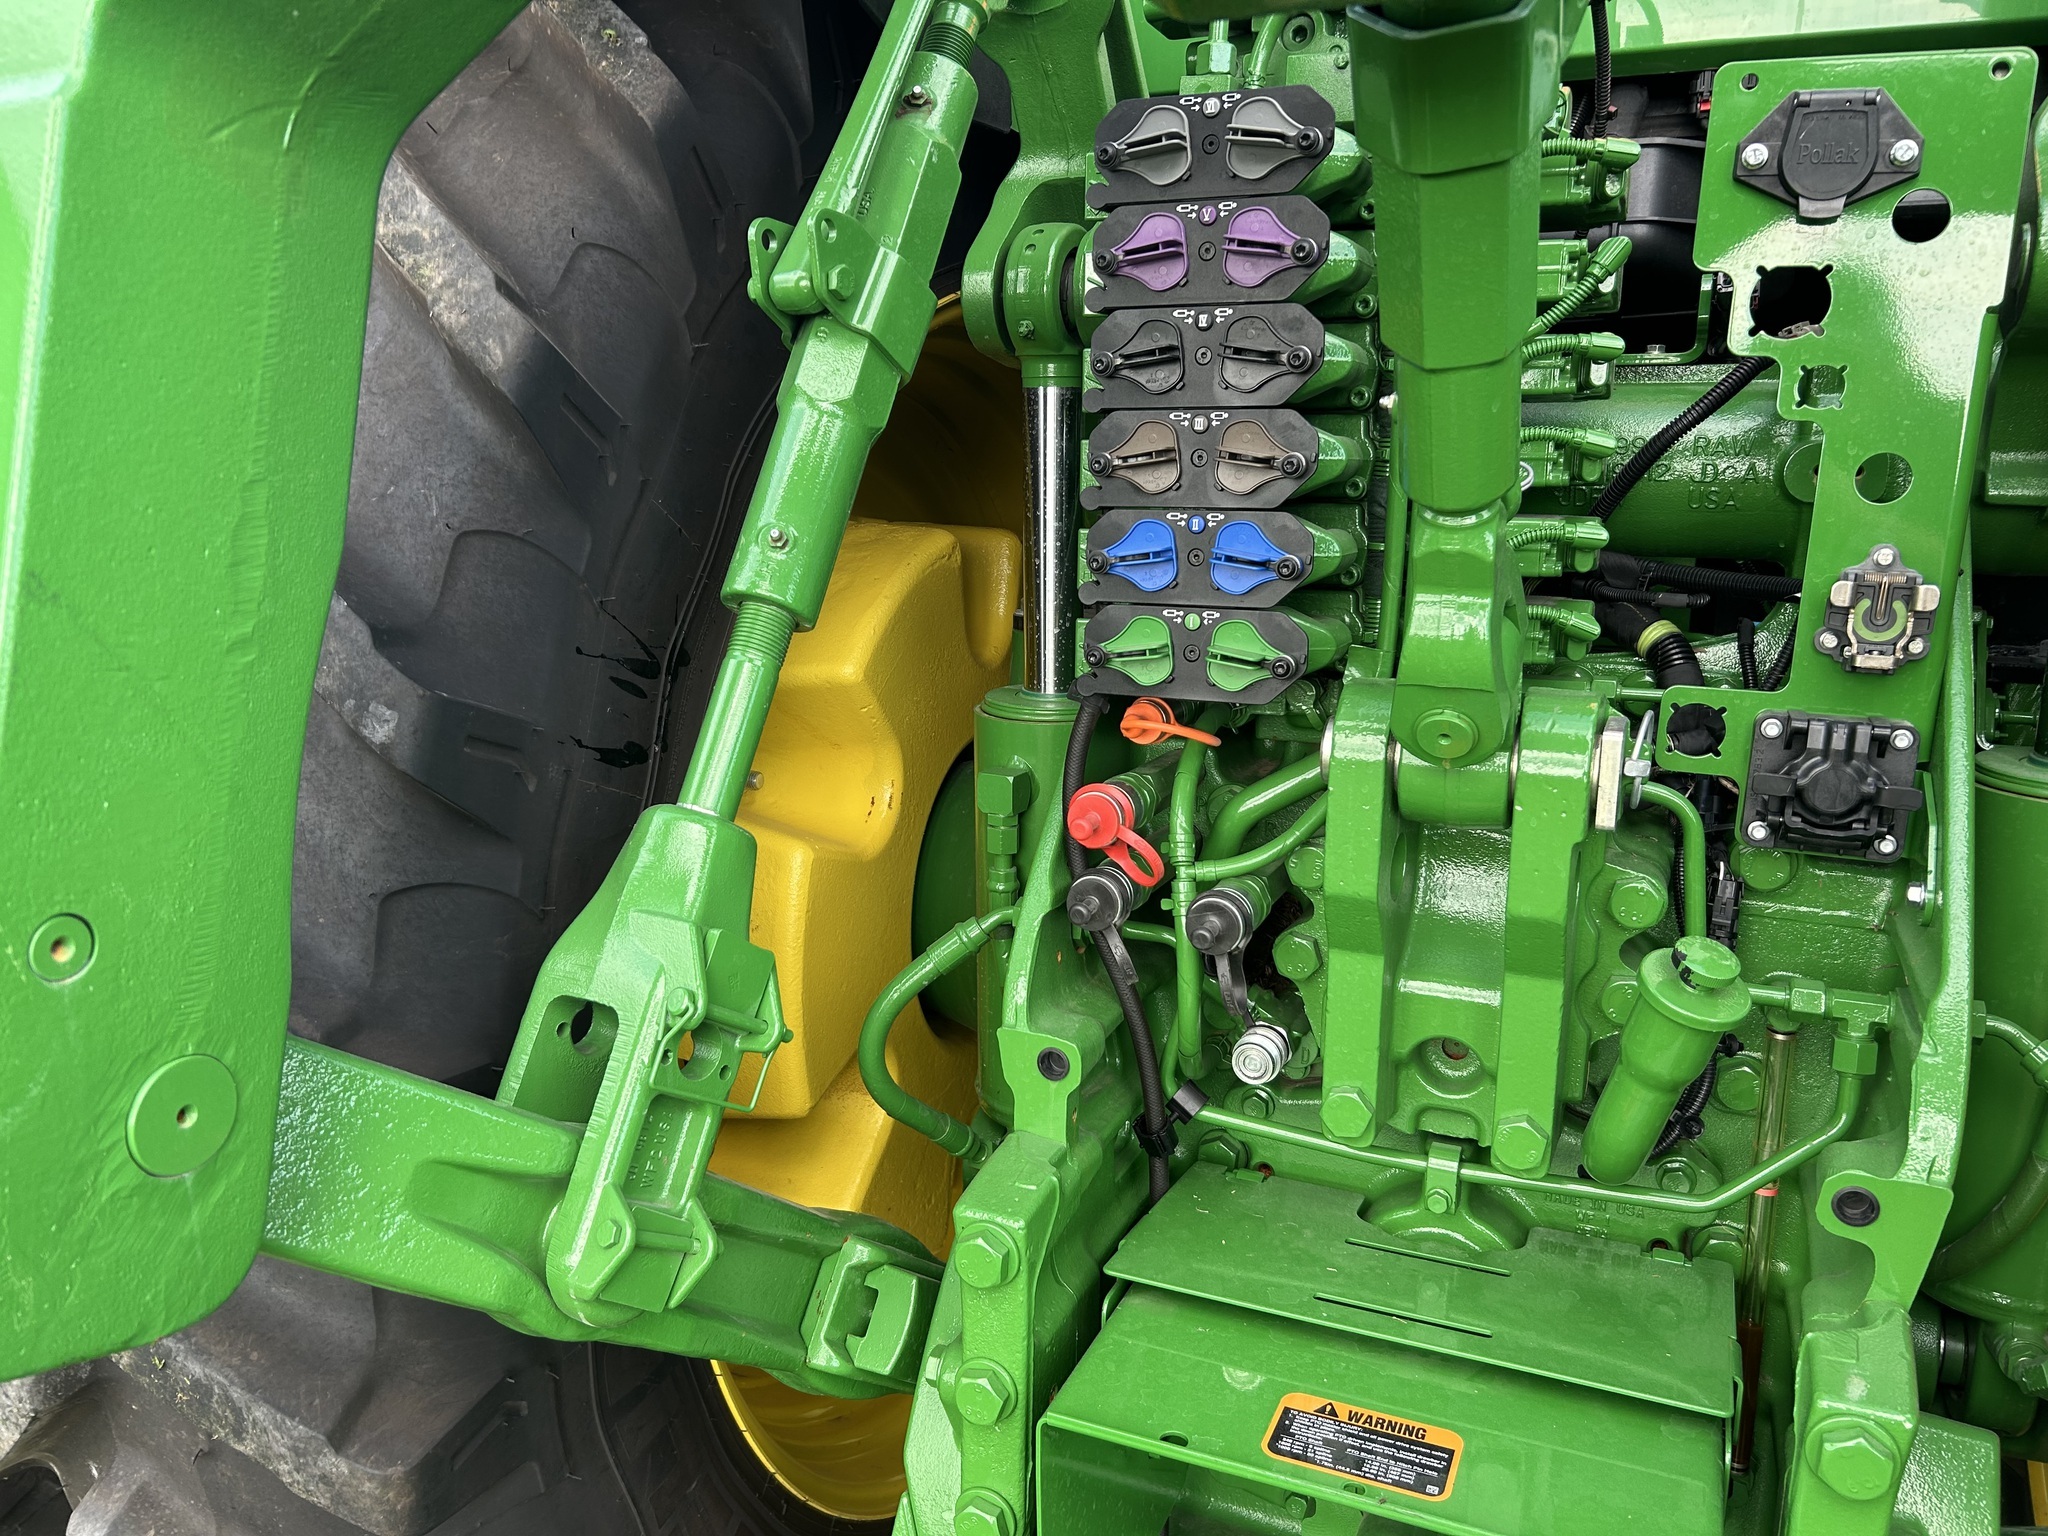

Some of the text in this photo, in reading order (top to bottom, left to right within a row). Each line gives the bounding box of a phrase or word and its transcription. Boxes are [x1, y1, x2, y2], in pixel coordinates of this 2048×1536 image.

[1205, 100, 1216, 114] VI
[1796, 141, 1860, 165] Pollak
[1202, 208, 1212, 221] V
[1198, 314, 1209, 327] IV
[1193, 418, 1204, 431] III
[1693, 435, 1756, 457] RAW
[1688, 487, 1740, 511] USA
[1191, 518, 1200, 531] II
[1616, 1203, 1645, 1219] USA
[1317, 1416, 1338, 1425] BODILY
[1339, 1422, 1363, 1431] INJURY:
[1347, 1409, 1428, 1441] WARNING
